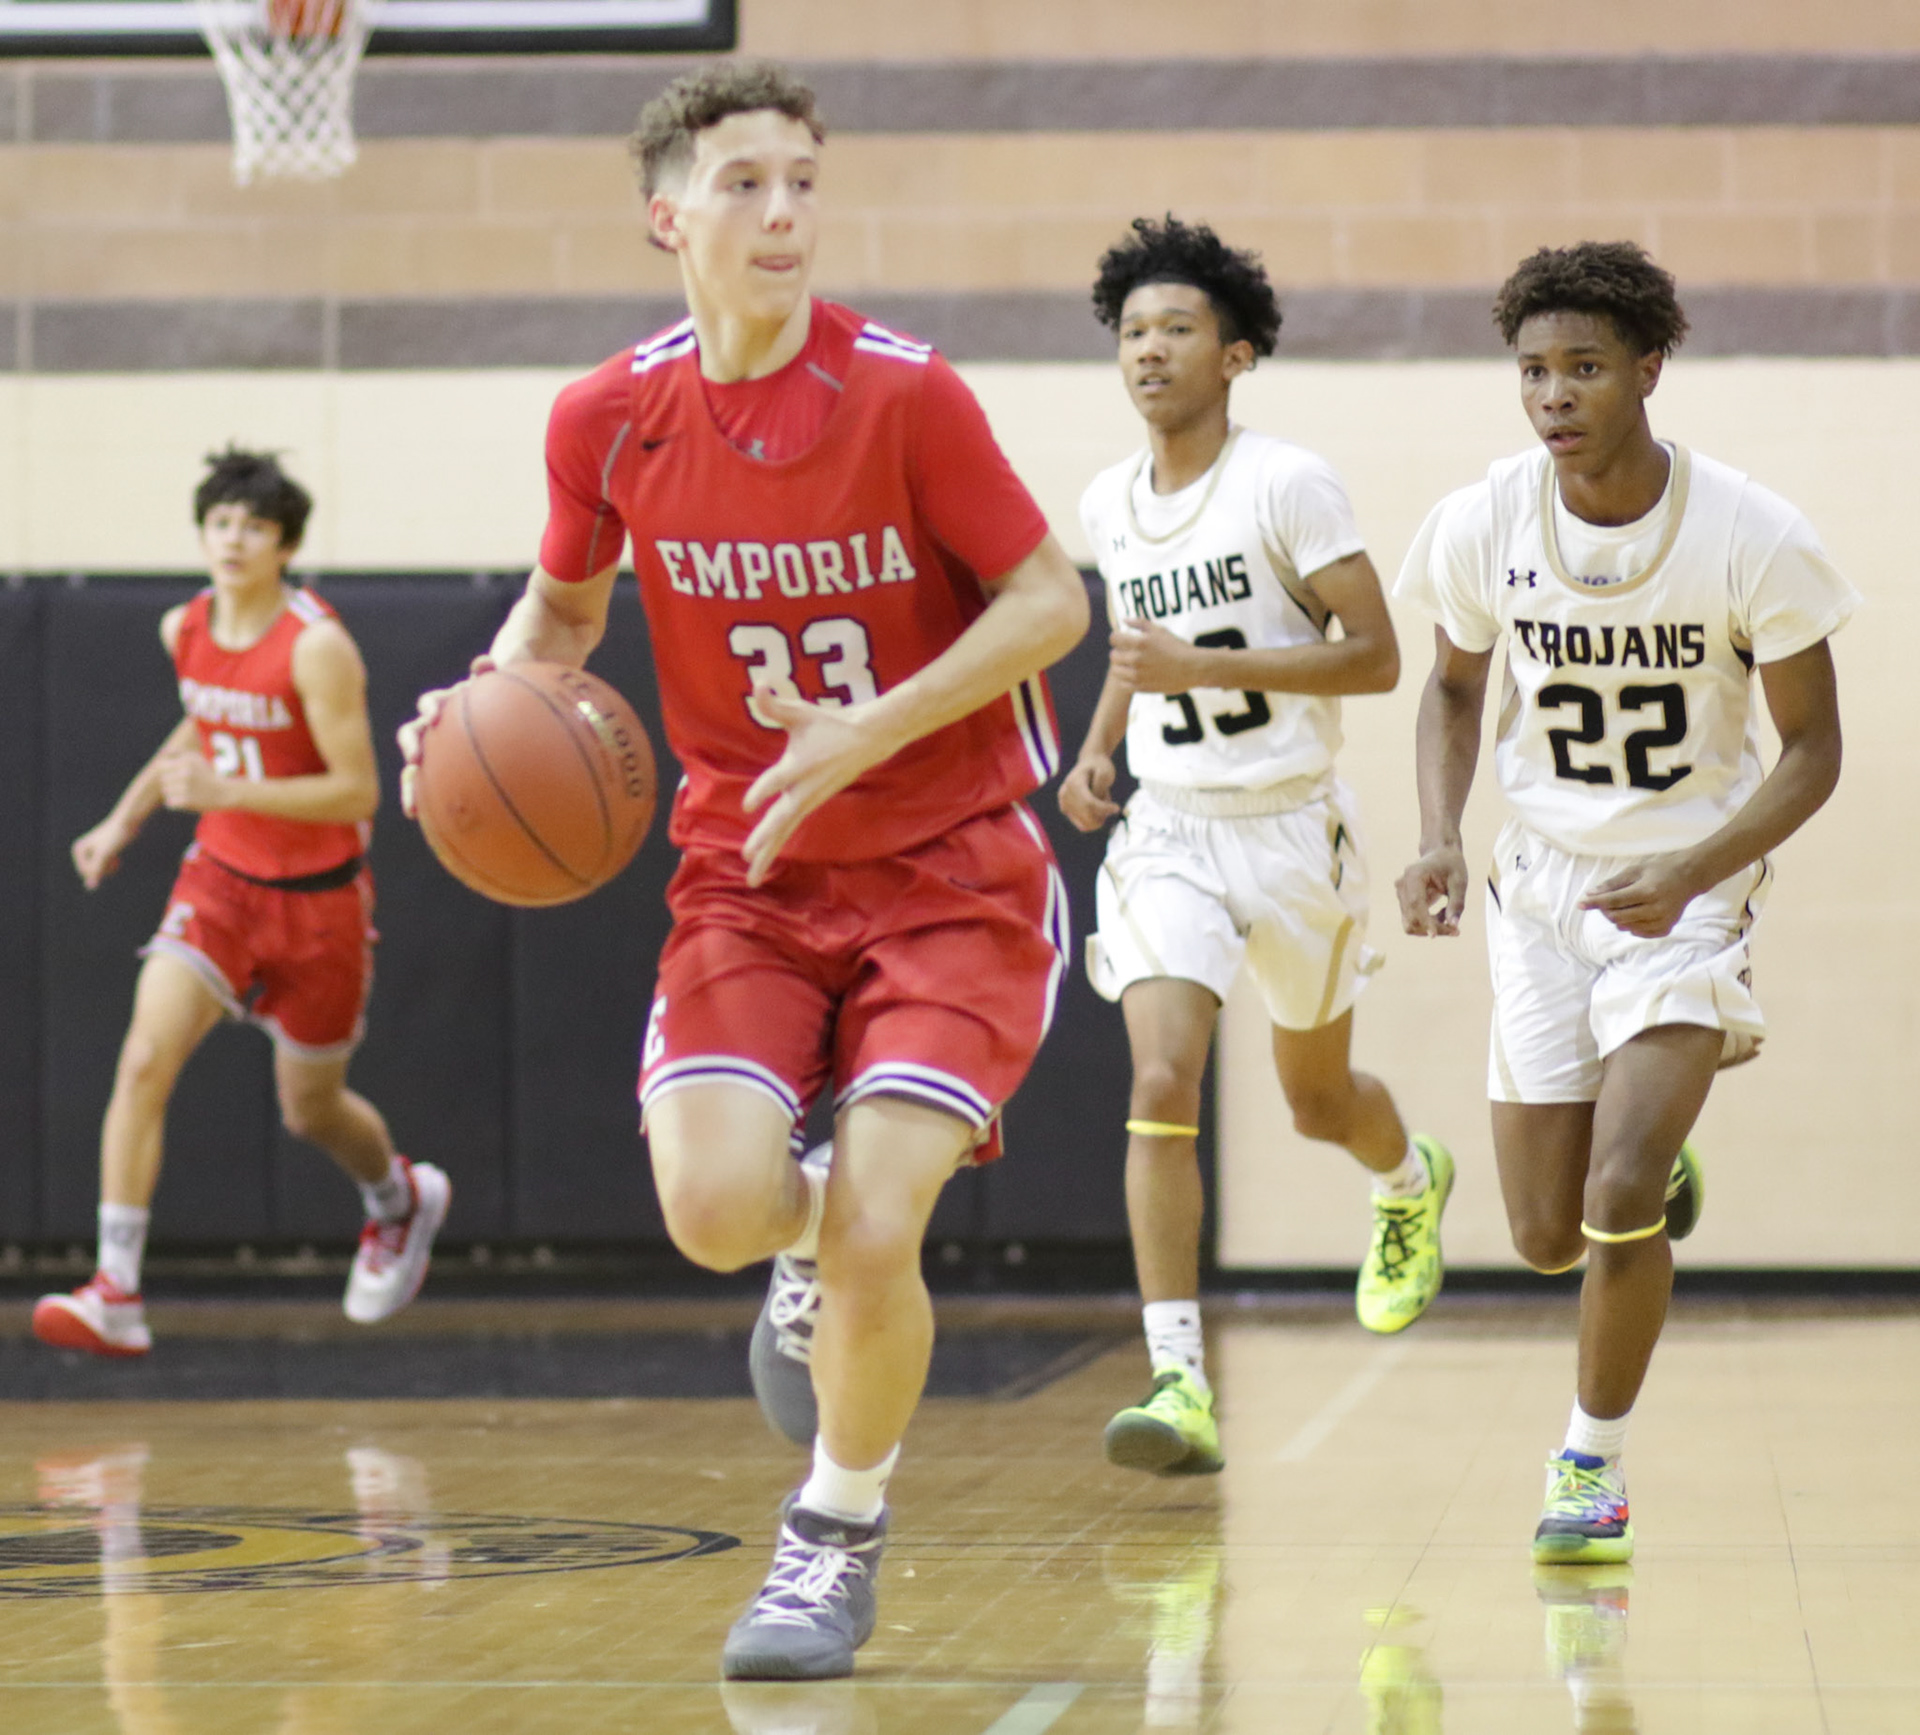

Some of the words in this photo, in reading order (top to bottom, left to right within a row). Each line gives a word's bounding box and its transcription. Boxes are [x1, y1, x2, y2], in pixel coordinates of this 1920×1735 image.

[655, 526, 916, 599] EMPORIA
[1119, 553, 1254, 621] TROJANS
[729, 615, 878, 731] 33
[1513, 618, 1706, 669] TROJANS
[1536, 682, 1694, 792] 22
